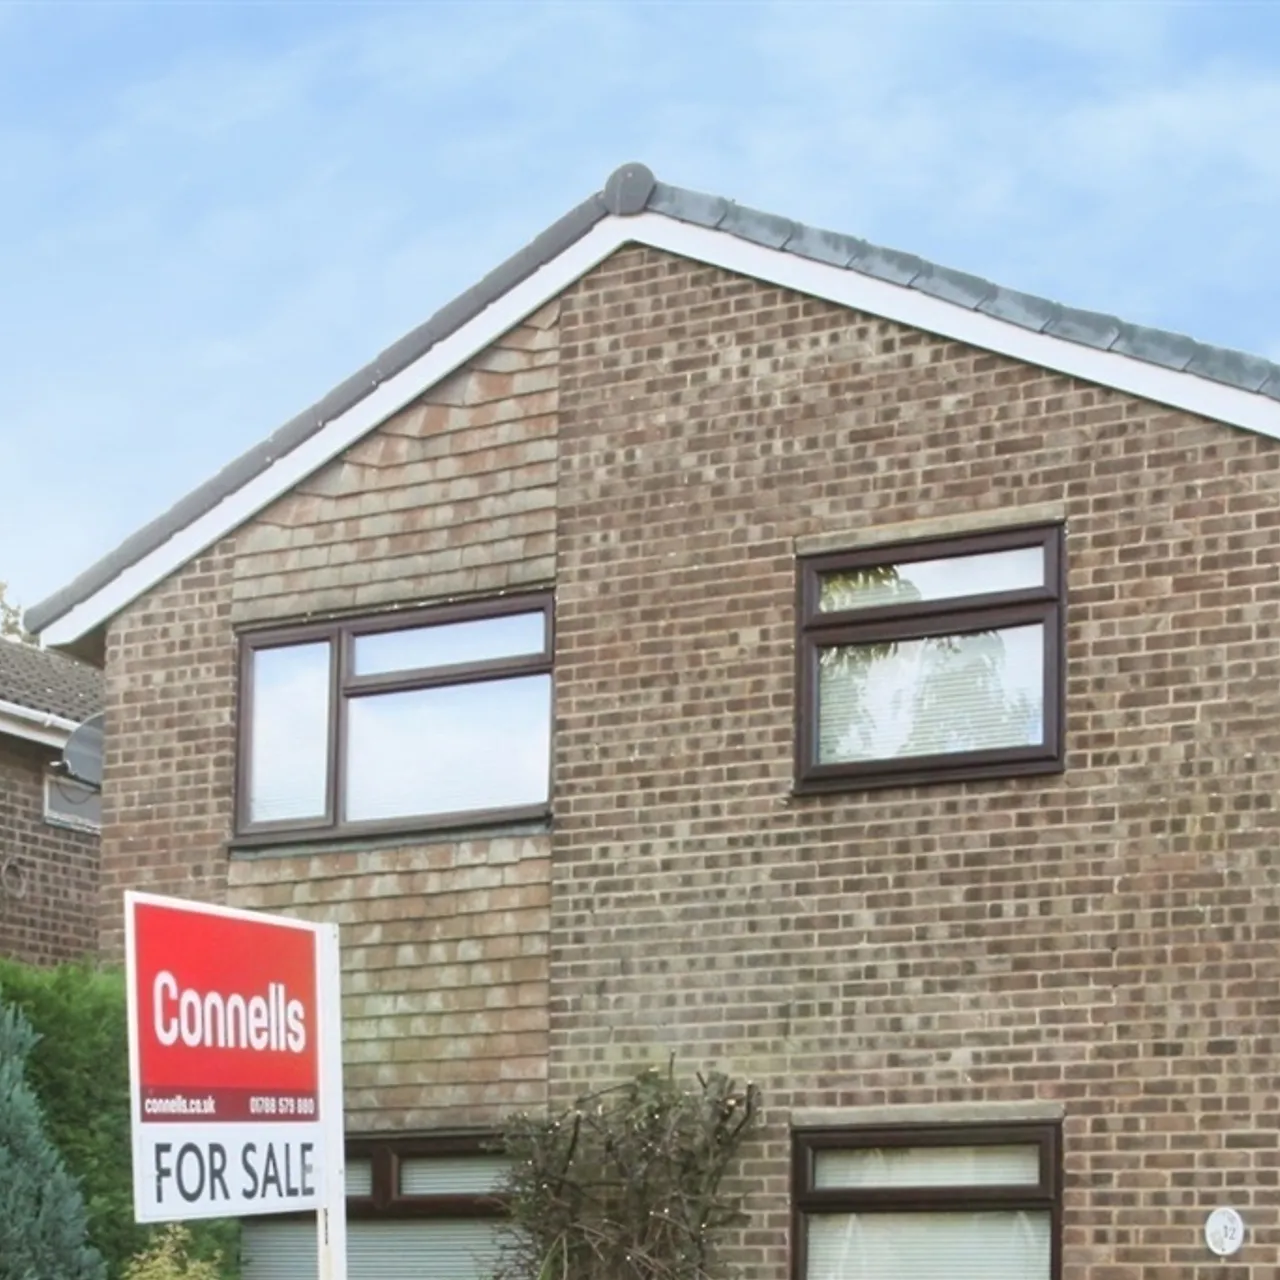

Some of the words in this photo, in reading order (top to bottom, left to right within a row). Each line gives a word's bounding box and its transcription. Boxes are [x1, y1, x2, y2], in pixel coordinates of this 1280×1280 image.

[153, 970, 306, 1053] Connells
[145, 1095, 216, 1114] connells.co.uk
[154, 1142, 230, 1203] FOR
[241, 1142, 315, 1200] SALE
